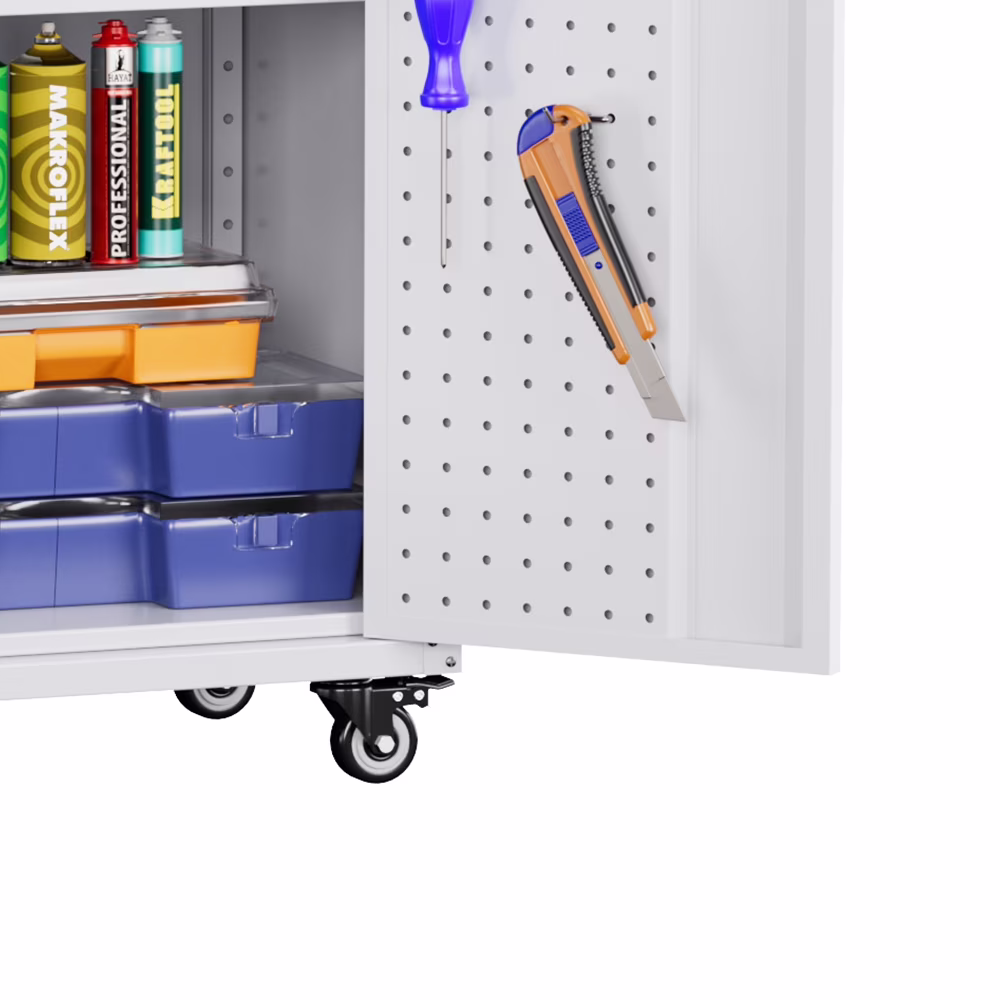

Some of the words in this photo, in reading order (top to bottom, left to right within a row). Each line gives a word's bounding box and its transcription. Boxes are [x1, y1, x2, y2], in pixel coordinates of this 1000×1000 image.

[49, 84, 69, 252] MAKROFLEX
[111, 98, 127, 258] PROFESSIONAL
[152, 84, 175, 219] KRAFTOOL
